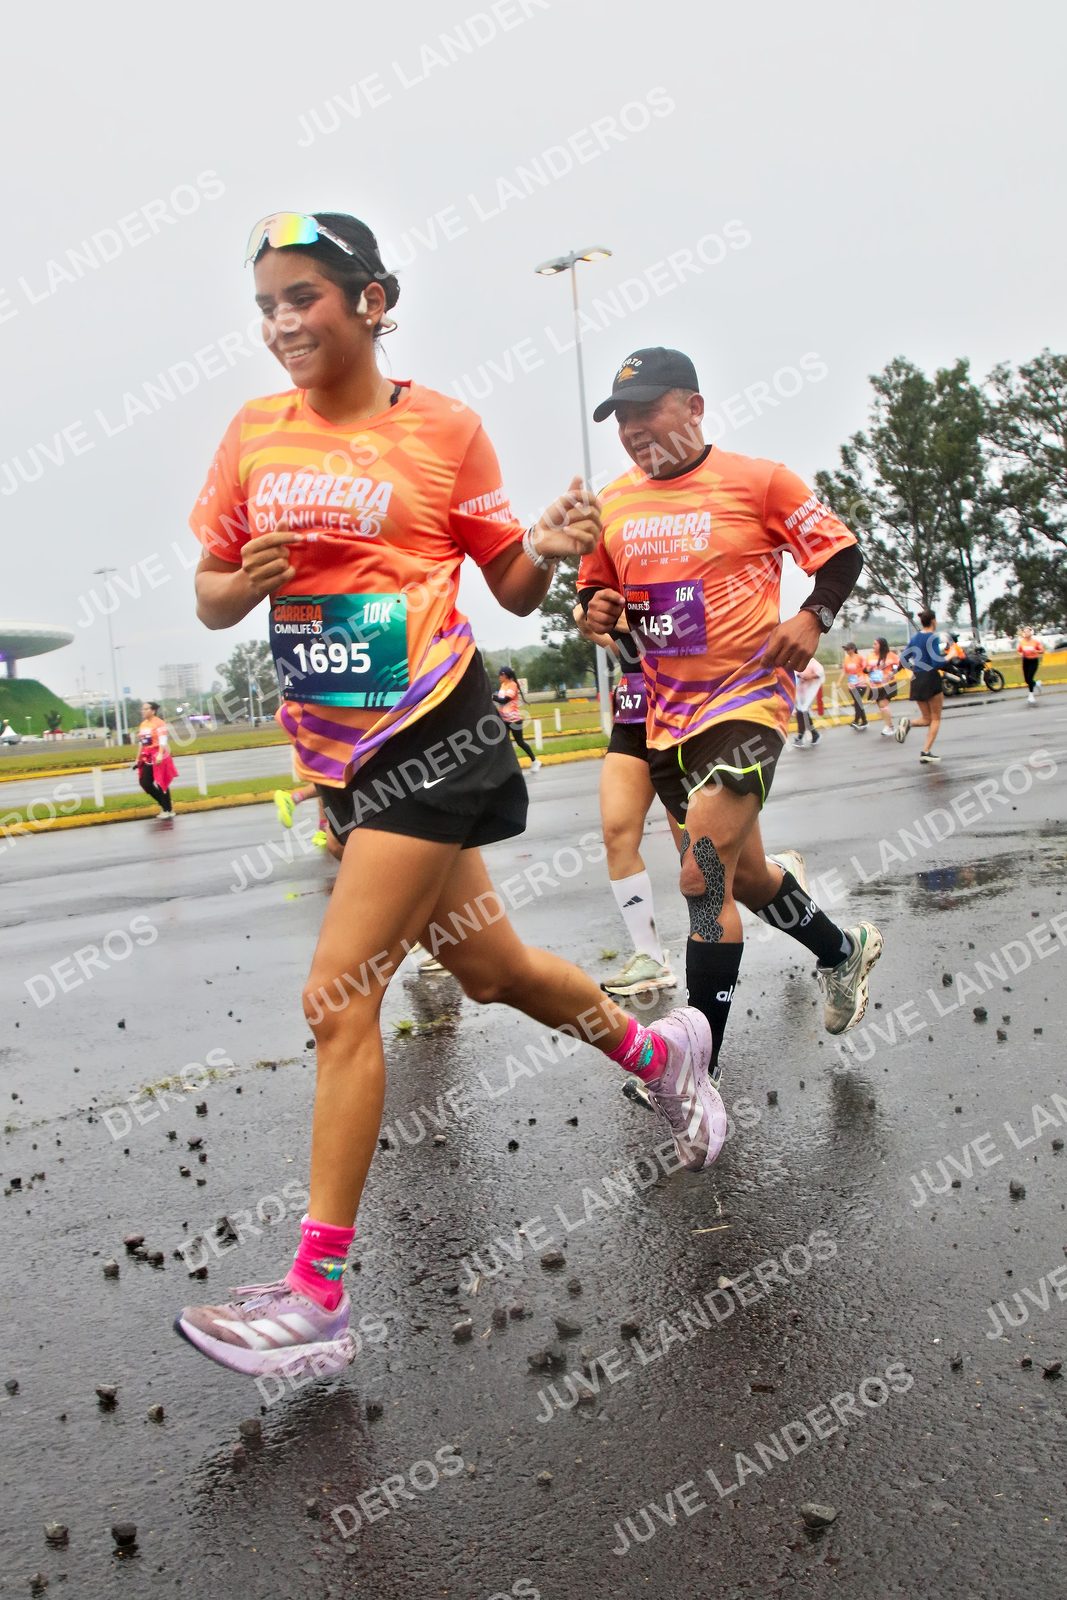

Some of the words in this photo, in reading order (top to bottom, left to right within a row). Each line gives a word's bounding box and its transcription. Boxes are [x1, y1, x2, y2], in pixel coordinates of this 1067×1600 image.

[255, 472, 393, 513] CARRERA
[623, 512, 711, 541] CARRERA
[625, 538, 689, 558] OMNILIFE
[274, 605, 322, 622] CARRERA
[363, 602, 394, 624] 10K
[274, 624, 312, 635] OMNILIFE
[640, 614, 673, 636] 143
[293, 643, 372, 674] 1695
